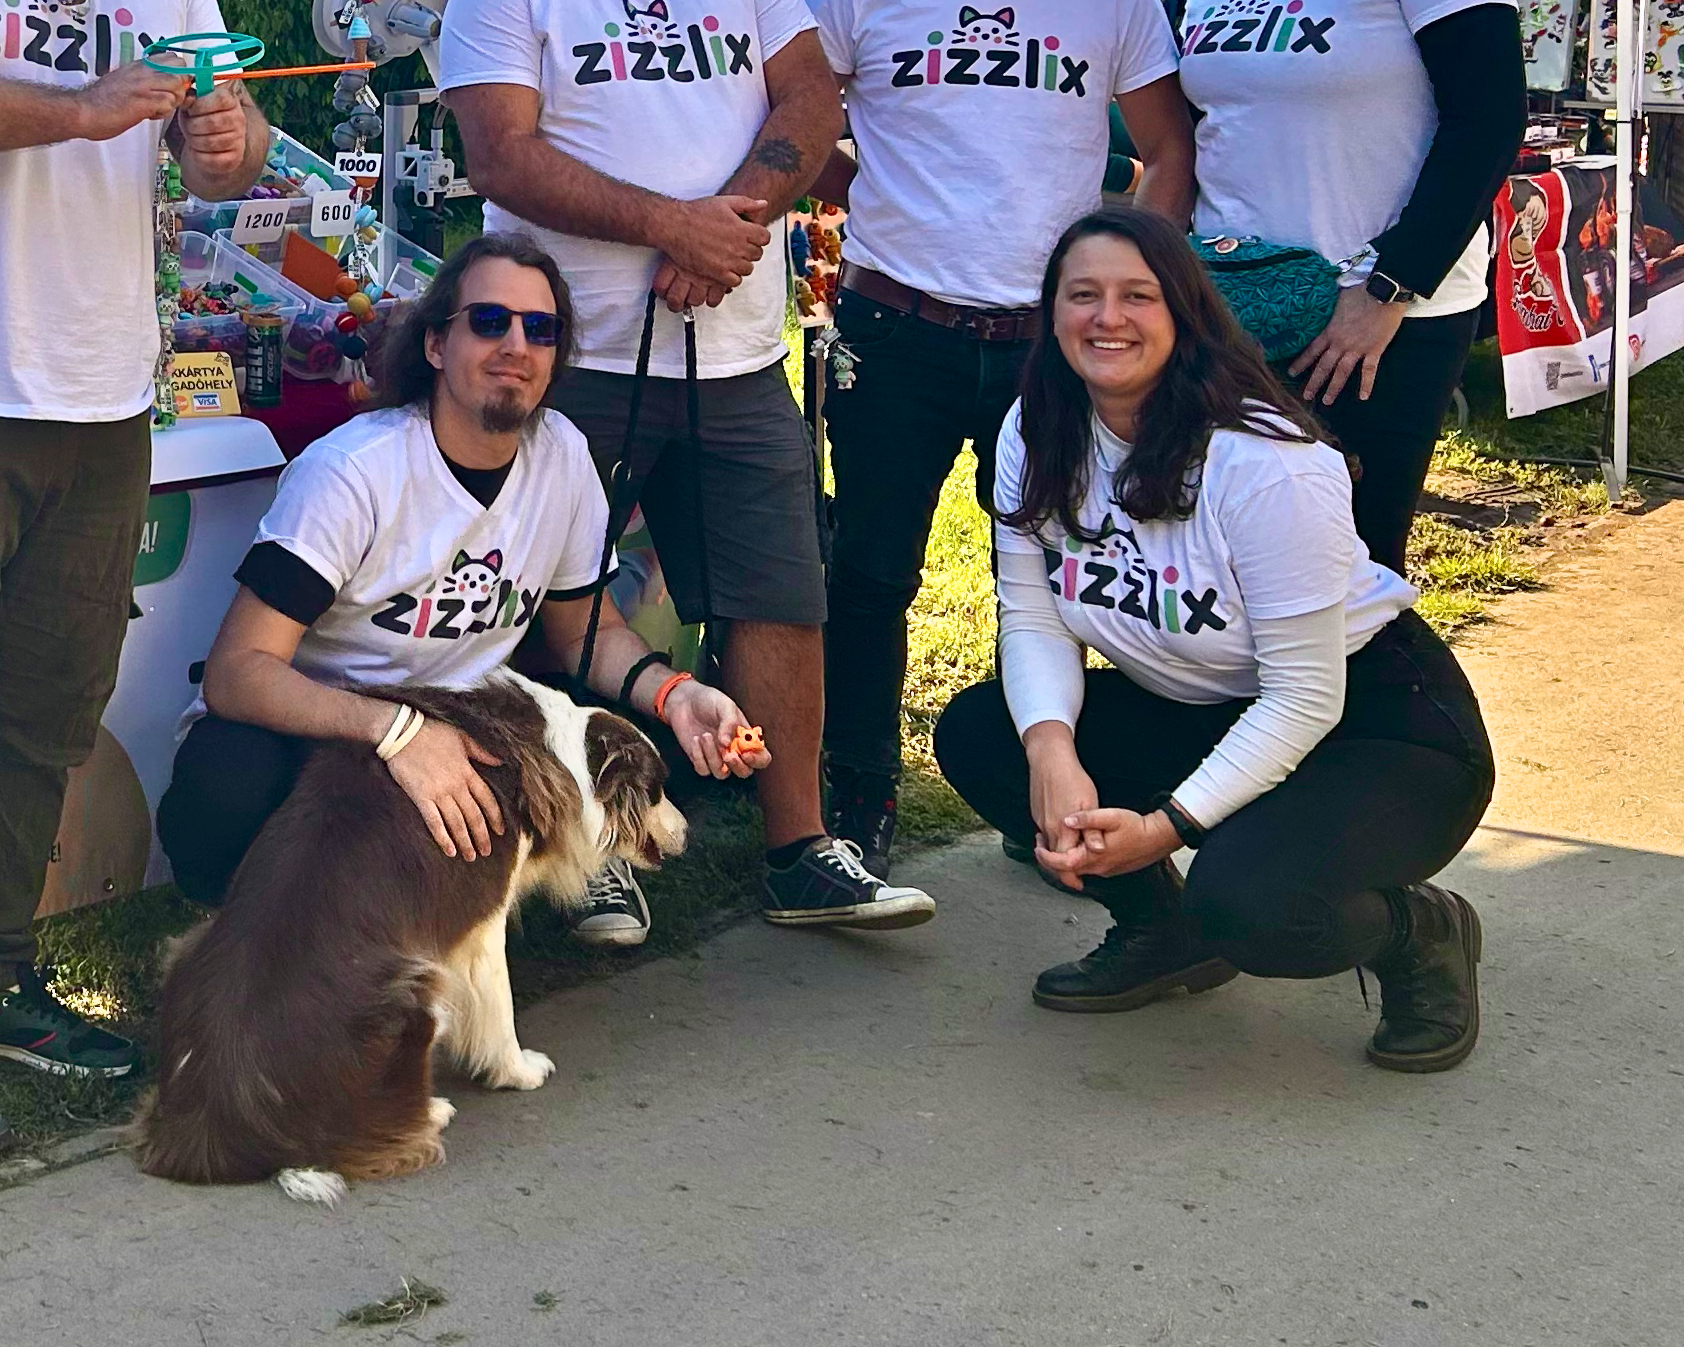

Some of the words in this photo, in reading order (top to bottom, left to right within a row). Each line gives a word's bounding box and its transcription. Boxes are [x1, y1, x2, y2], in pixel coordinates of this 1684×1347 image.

[572, 15, 753, 85] zizzlix
[891, 31, 1089, 97] zizzlix
[338, 158, 377, 173] 1000
[245, 211, 284, 229] 1200
[321, 203, 351, 222] 600
[172, 365, 225, 378] KKÁRTYA
[247, 346, 263, 392] HELL
[171, 378, 233, 391] GADÓHELY
[197, 398, 218, 406] VISA
